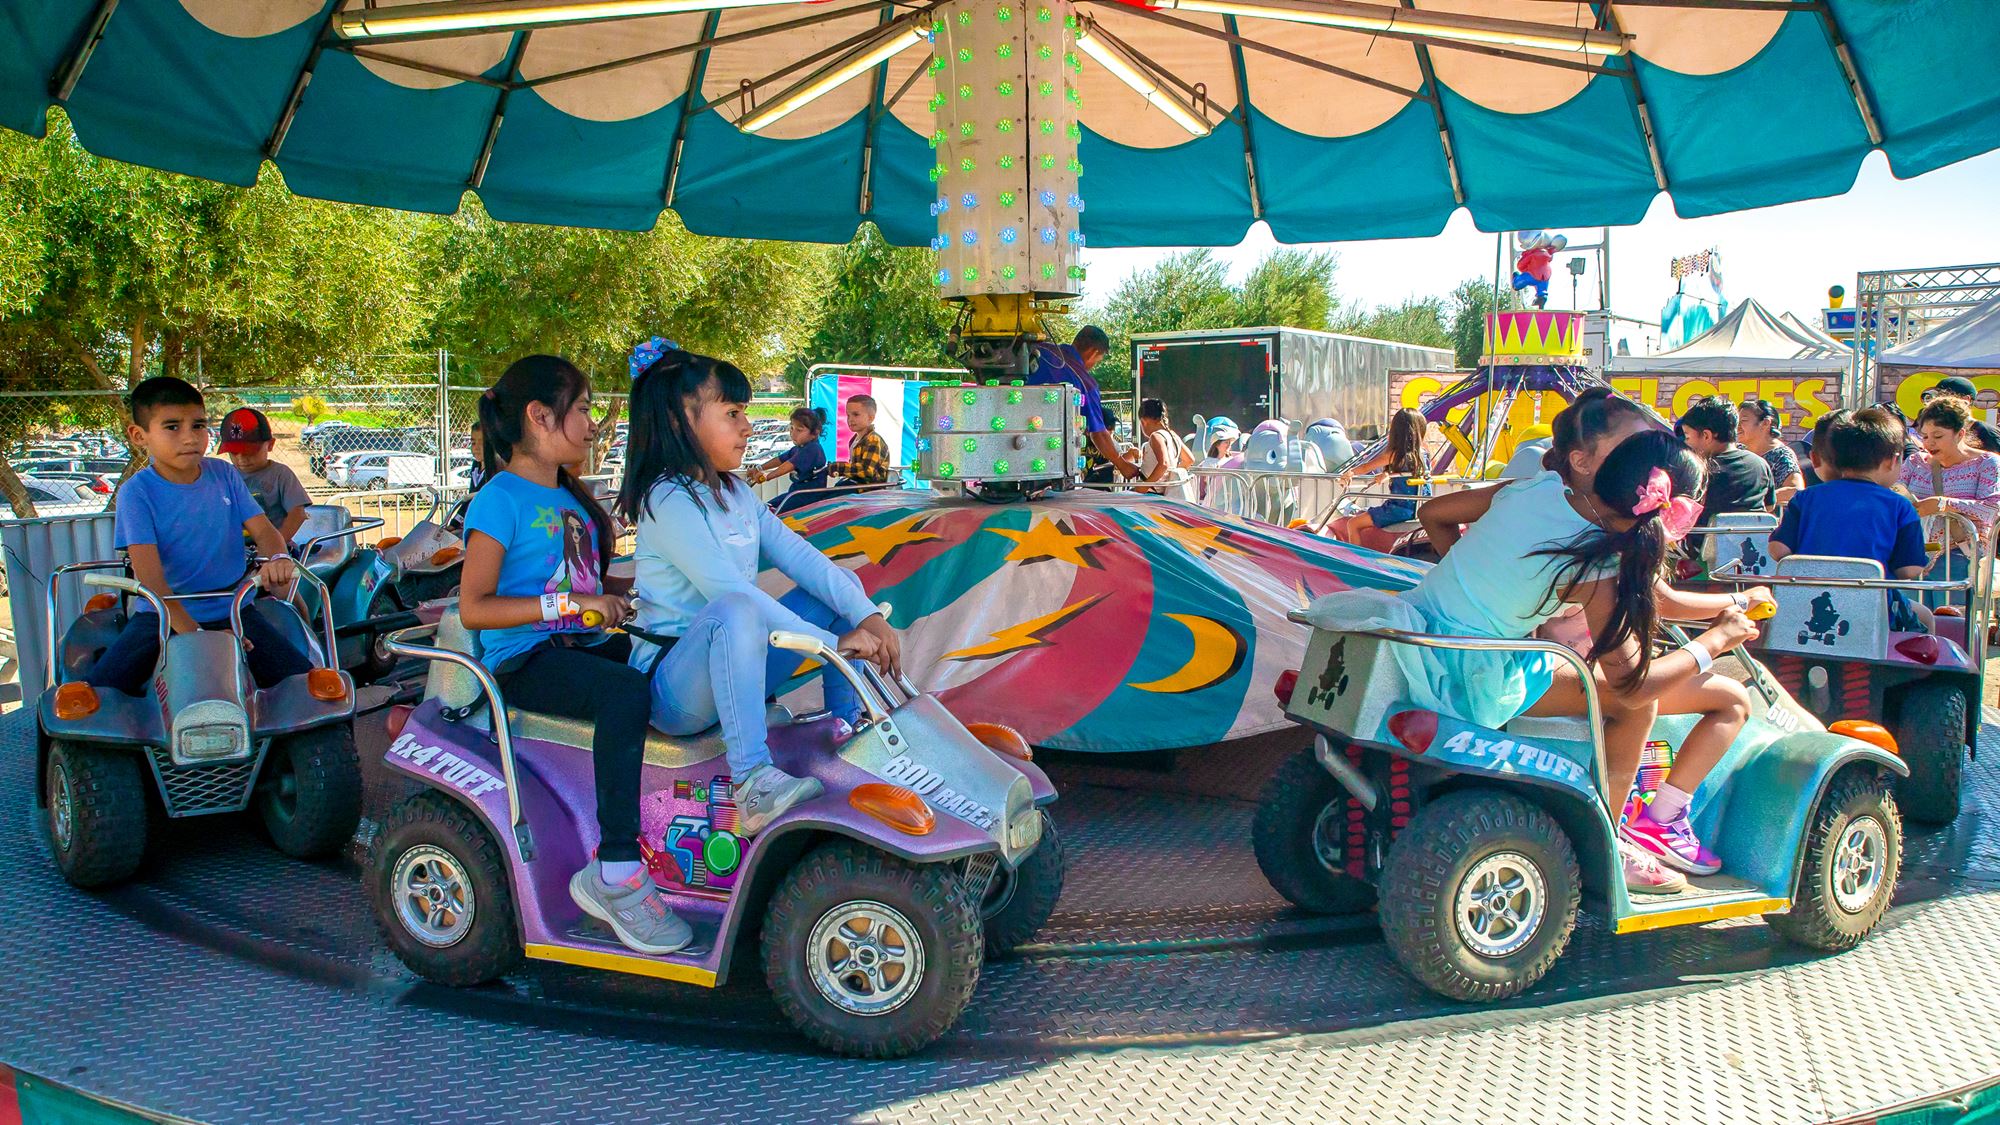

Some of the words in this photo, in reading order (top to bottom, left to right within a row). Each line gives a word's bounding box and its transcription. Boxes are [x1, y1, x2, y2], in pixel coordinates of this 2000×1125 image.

[1766, 703, 1799, 733] 600
[428, 752, 507, 797] TUFF
[880, 755, 945, 795] 600
[1443, 731, 1515, 761] 4x4
[1517, 743, 1585, 782] TUFF
